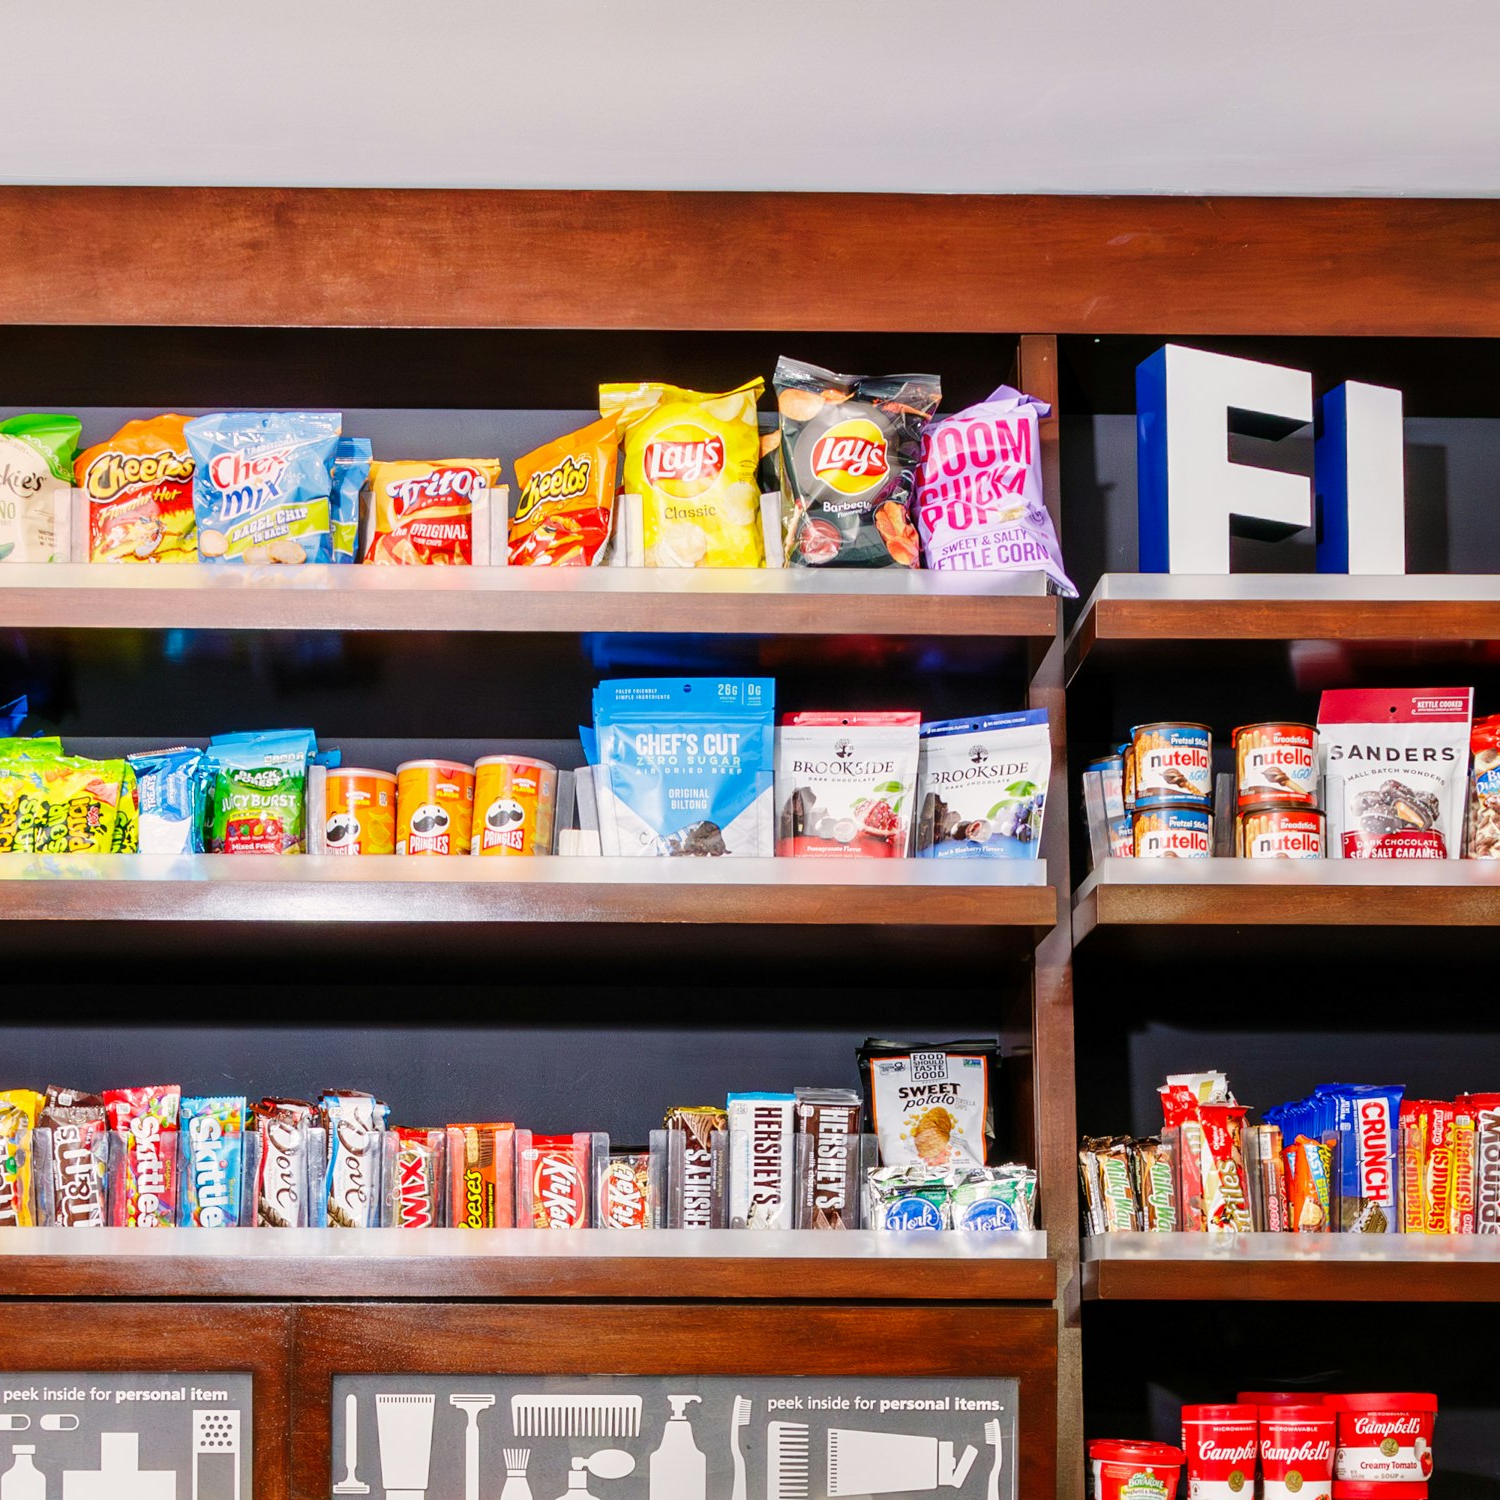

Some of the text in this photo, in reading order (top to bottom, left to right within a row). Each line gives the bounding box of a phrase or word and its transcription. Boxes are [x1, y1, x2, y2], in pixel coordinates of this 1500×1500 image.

[652, 439, 721, 482] Lay's
[817, 437, 886, 476] Lay's
[87, 452, 196, 501] Cheetos
[211, 450, 291, 489] Chex
[386, 468, 487, 519] Fritos
[519, 459, 590, 518] Cheetos
[665, 505, 717, 520] Classic
[232, 507, 308, 542] BAGEL CHIP
[410, 523, 468, 540] ORIGINAL
[942, 529, 1027, 555] SWEET & SALTY
[999, 542, 1049, 564] CORN
[636, 733, 740, 756] CHEF'S CUT
[1273, 735, 1310, 746] Breadsticks
[637, 756, 741, 766] ZERO SUGAR
[1151, 749, 1208, 769] nutella
[1252, 748, 1312, 768] nutella
[1330, 744, 1456, 762] SANDERS
[793, 760, 894, 777] BROOKSIDE
[931, 761, 1029, 785] BROOKSIDE
[669, 789, 709, 798] ORIGINAL
[671, 800, 707, 810] BILTONG
[410, 836, 449, 854] PRINGLES
[484, 830, 523, 850] PRINGLES
[1148, 829, 1208, 851] nutella
[1260, 831, 1320, 851] nutella
[1356, 839, 1438, 848] DARK CHOCOLATE
[913, 1064, 945, 1073] TASTE
[914, 1071, 945, 1079] GOOD
[898, 1082, 962, 1100] SWEET
[903, 1093, 955, 1112] potato
[753, 1107, 782, 1205] HERSHEY'S
[815, 1109, 848, 1209] HERSHEY'S
[1361, 1101, 1390, 1202] CRUNCH
[130, 1117, 165, 1227] Skittles
[189, 1117, 229, 1227] Skittle
[1428, 1149, 1449, 1229] Starburst
[3, 1387, 228, 1403] peek inside for personal item
[768, 1395, 1005, 1415] peek inside for personal items.
[1354, 1417, 1420, 1435] Campbell's
[1260, 1439, 1330, 1464] Campbell's
